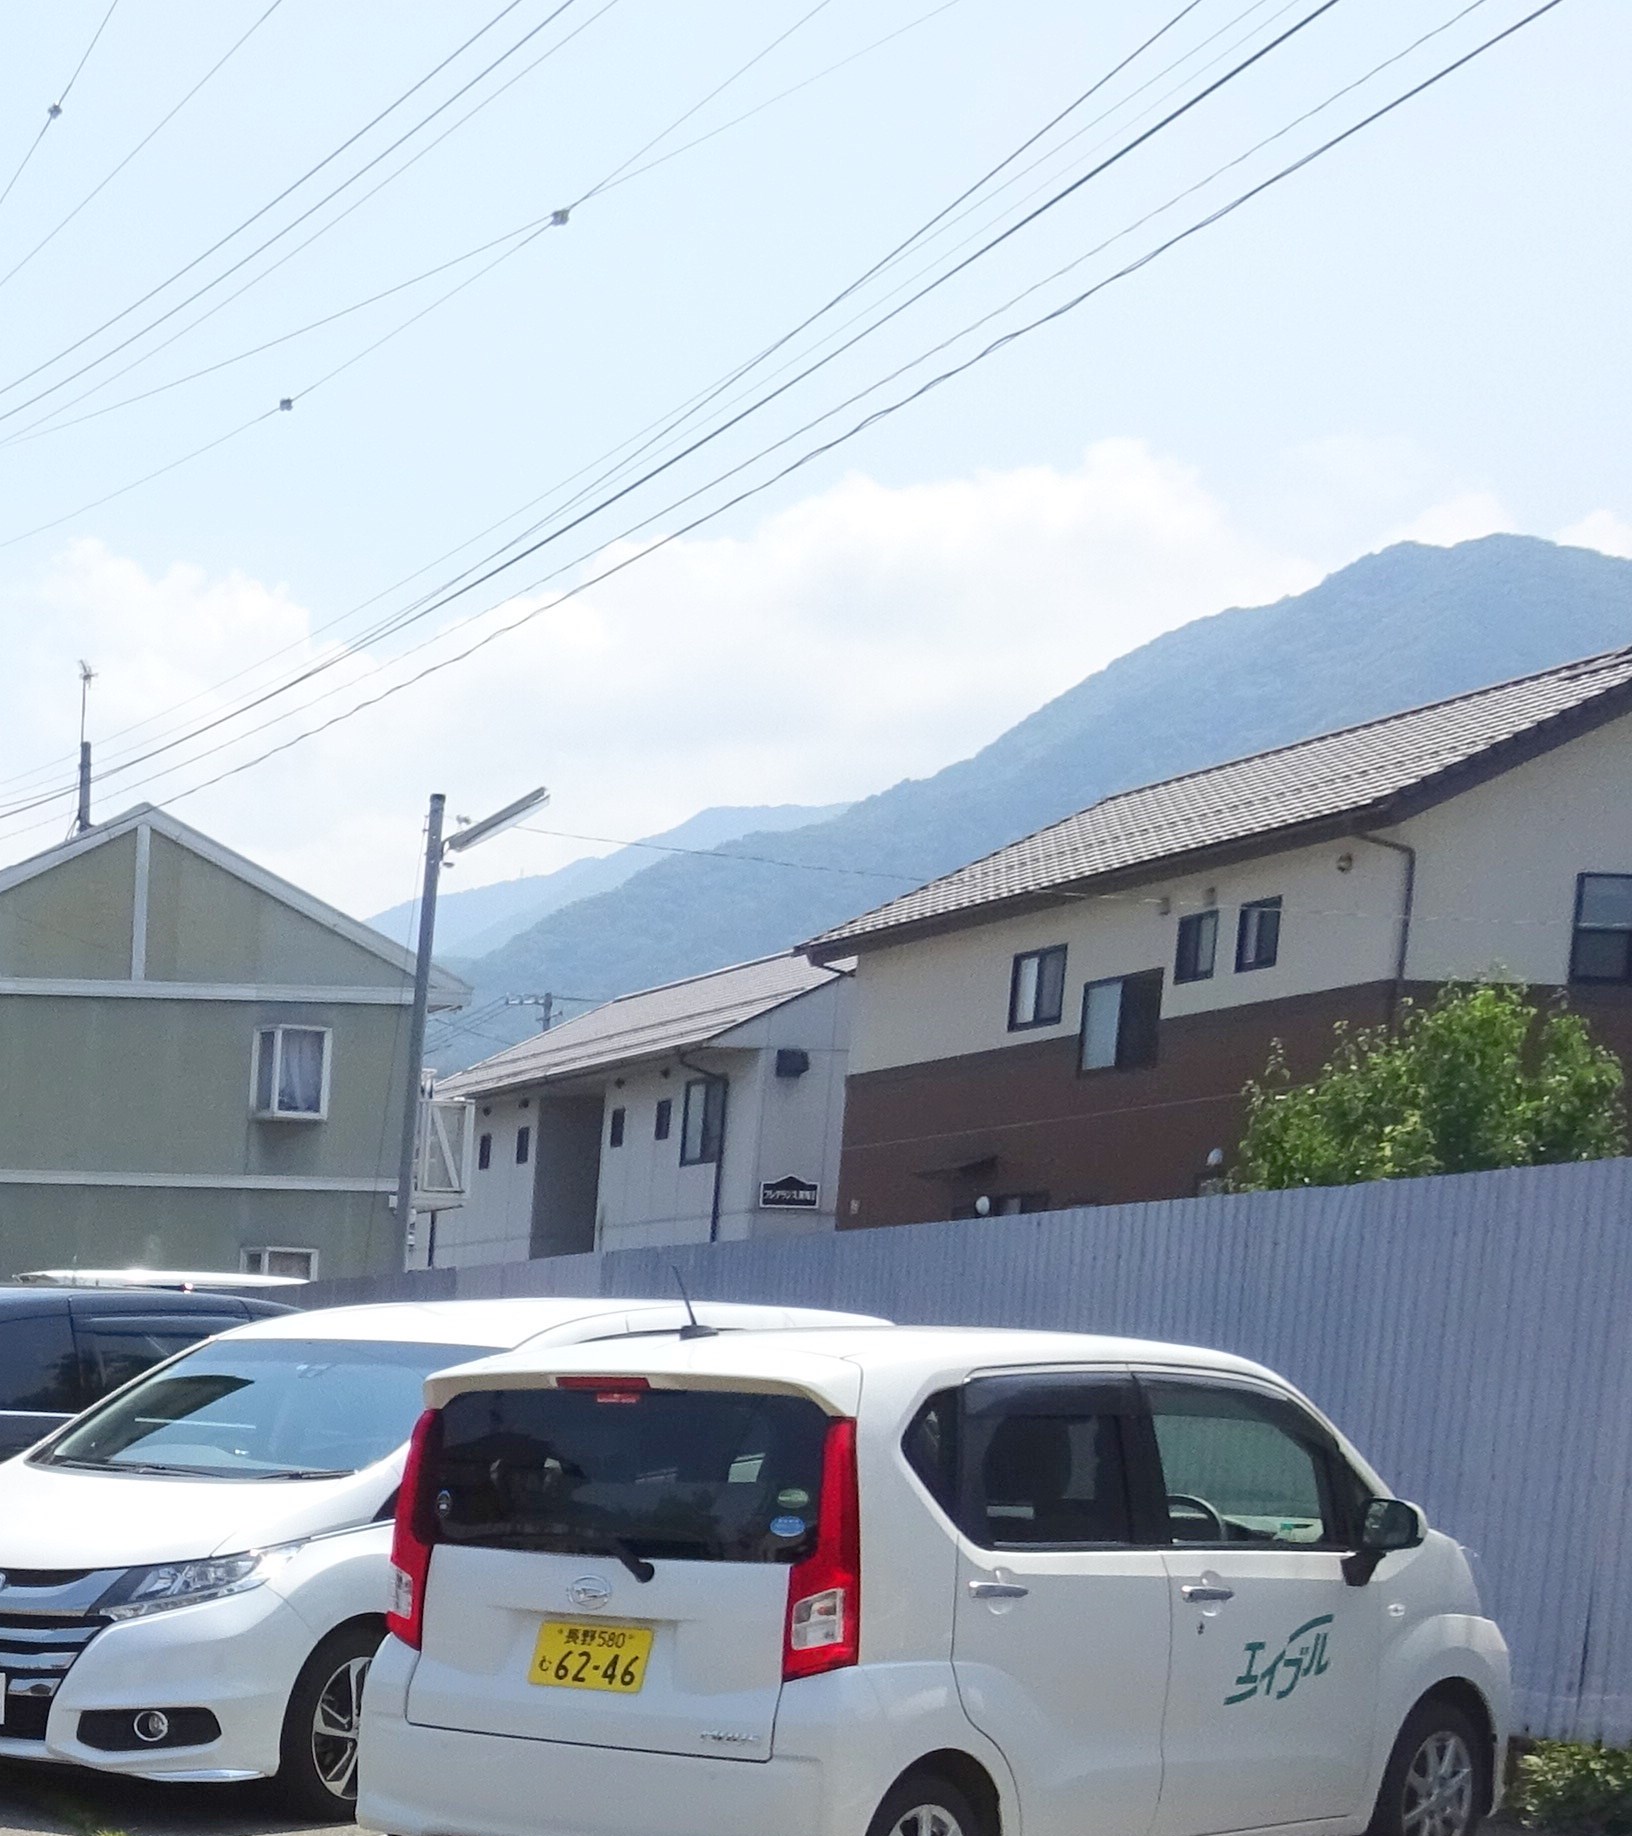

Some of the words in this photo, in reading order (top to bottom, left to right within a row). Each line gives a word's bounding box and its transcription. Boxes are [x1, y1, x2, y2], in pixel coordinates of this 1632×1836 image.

[554, 1650, 639, 1686] 62-46
[1223, 1613, 1334, 1706] エイブル
